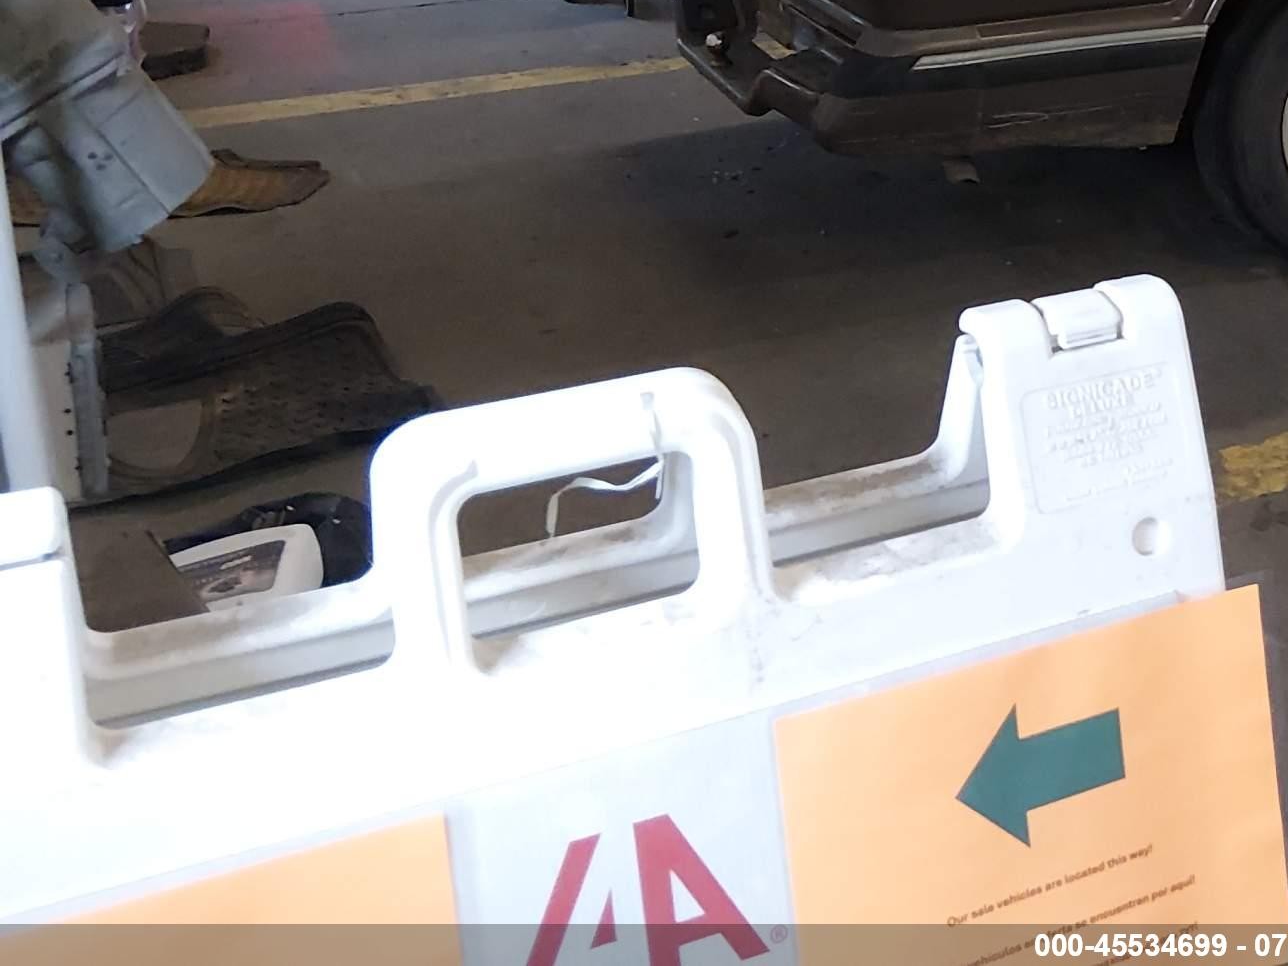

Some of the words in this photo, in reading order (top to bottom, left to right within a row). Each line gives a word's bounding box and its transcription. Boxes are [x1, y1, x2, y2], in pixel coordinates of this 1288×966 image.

[946, 913, 969, 928] Our
[997, 885, 1043, 909] vehicles
[1045, 878, 1063, 891] are
[1064, 862, 1106, 884] located
[1107, 854, 1128, 869] this
